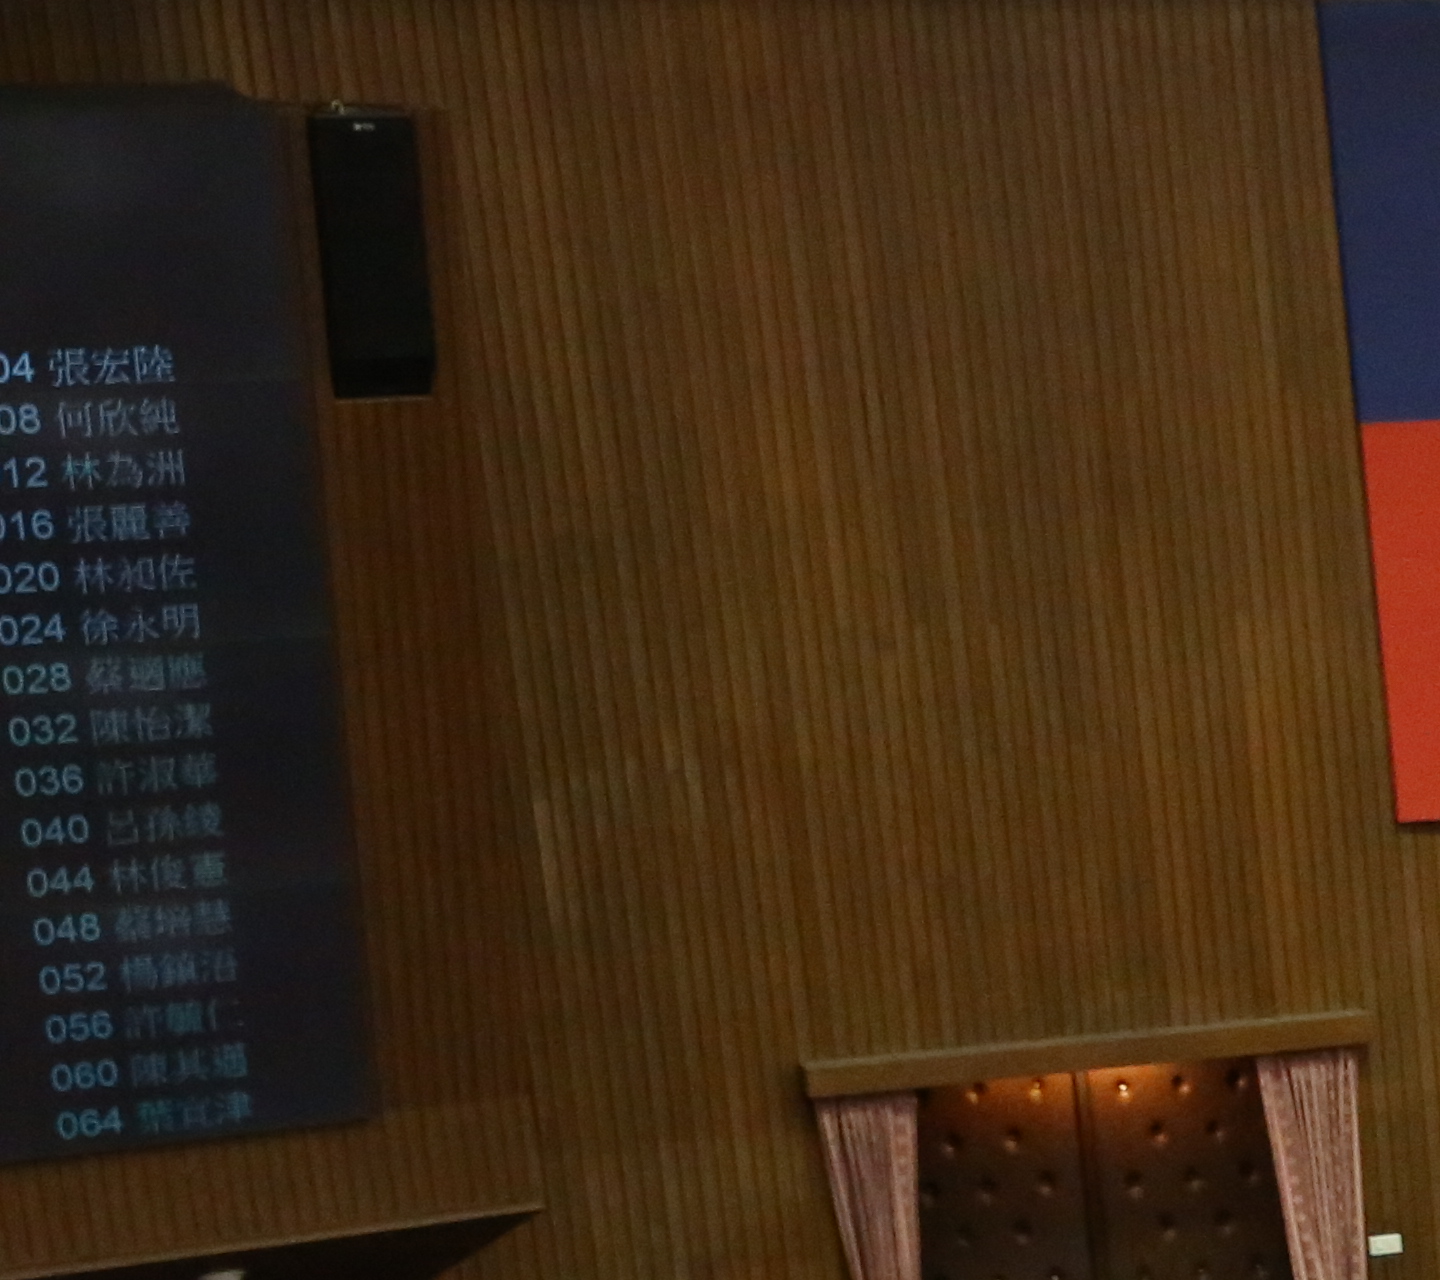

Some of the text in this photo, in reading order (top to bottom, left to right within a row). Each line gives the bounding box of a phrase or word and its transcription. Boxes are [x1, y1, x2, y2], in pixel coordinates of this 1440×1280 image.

[0, 613, 66, 646] 024
[3, 661, 72, 695] 028
[8, 713, 78, 747] 032
[14, 764, 85, 798] 036
[20, 814, 90, 848] 040
[26, 865, 95, 898] 044
[32, 912, 101, 946] 048
[38, 961, 106, 995] 052
[44, 1010, 113, 1044] 056
[50, 1059, 119, 1092] 060
[55, 1107, 124, 1141] 064
